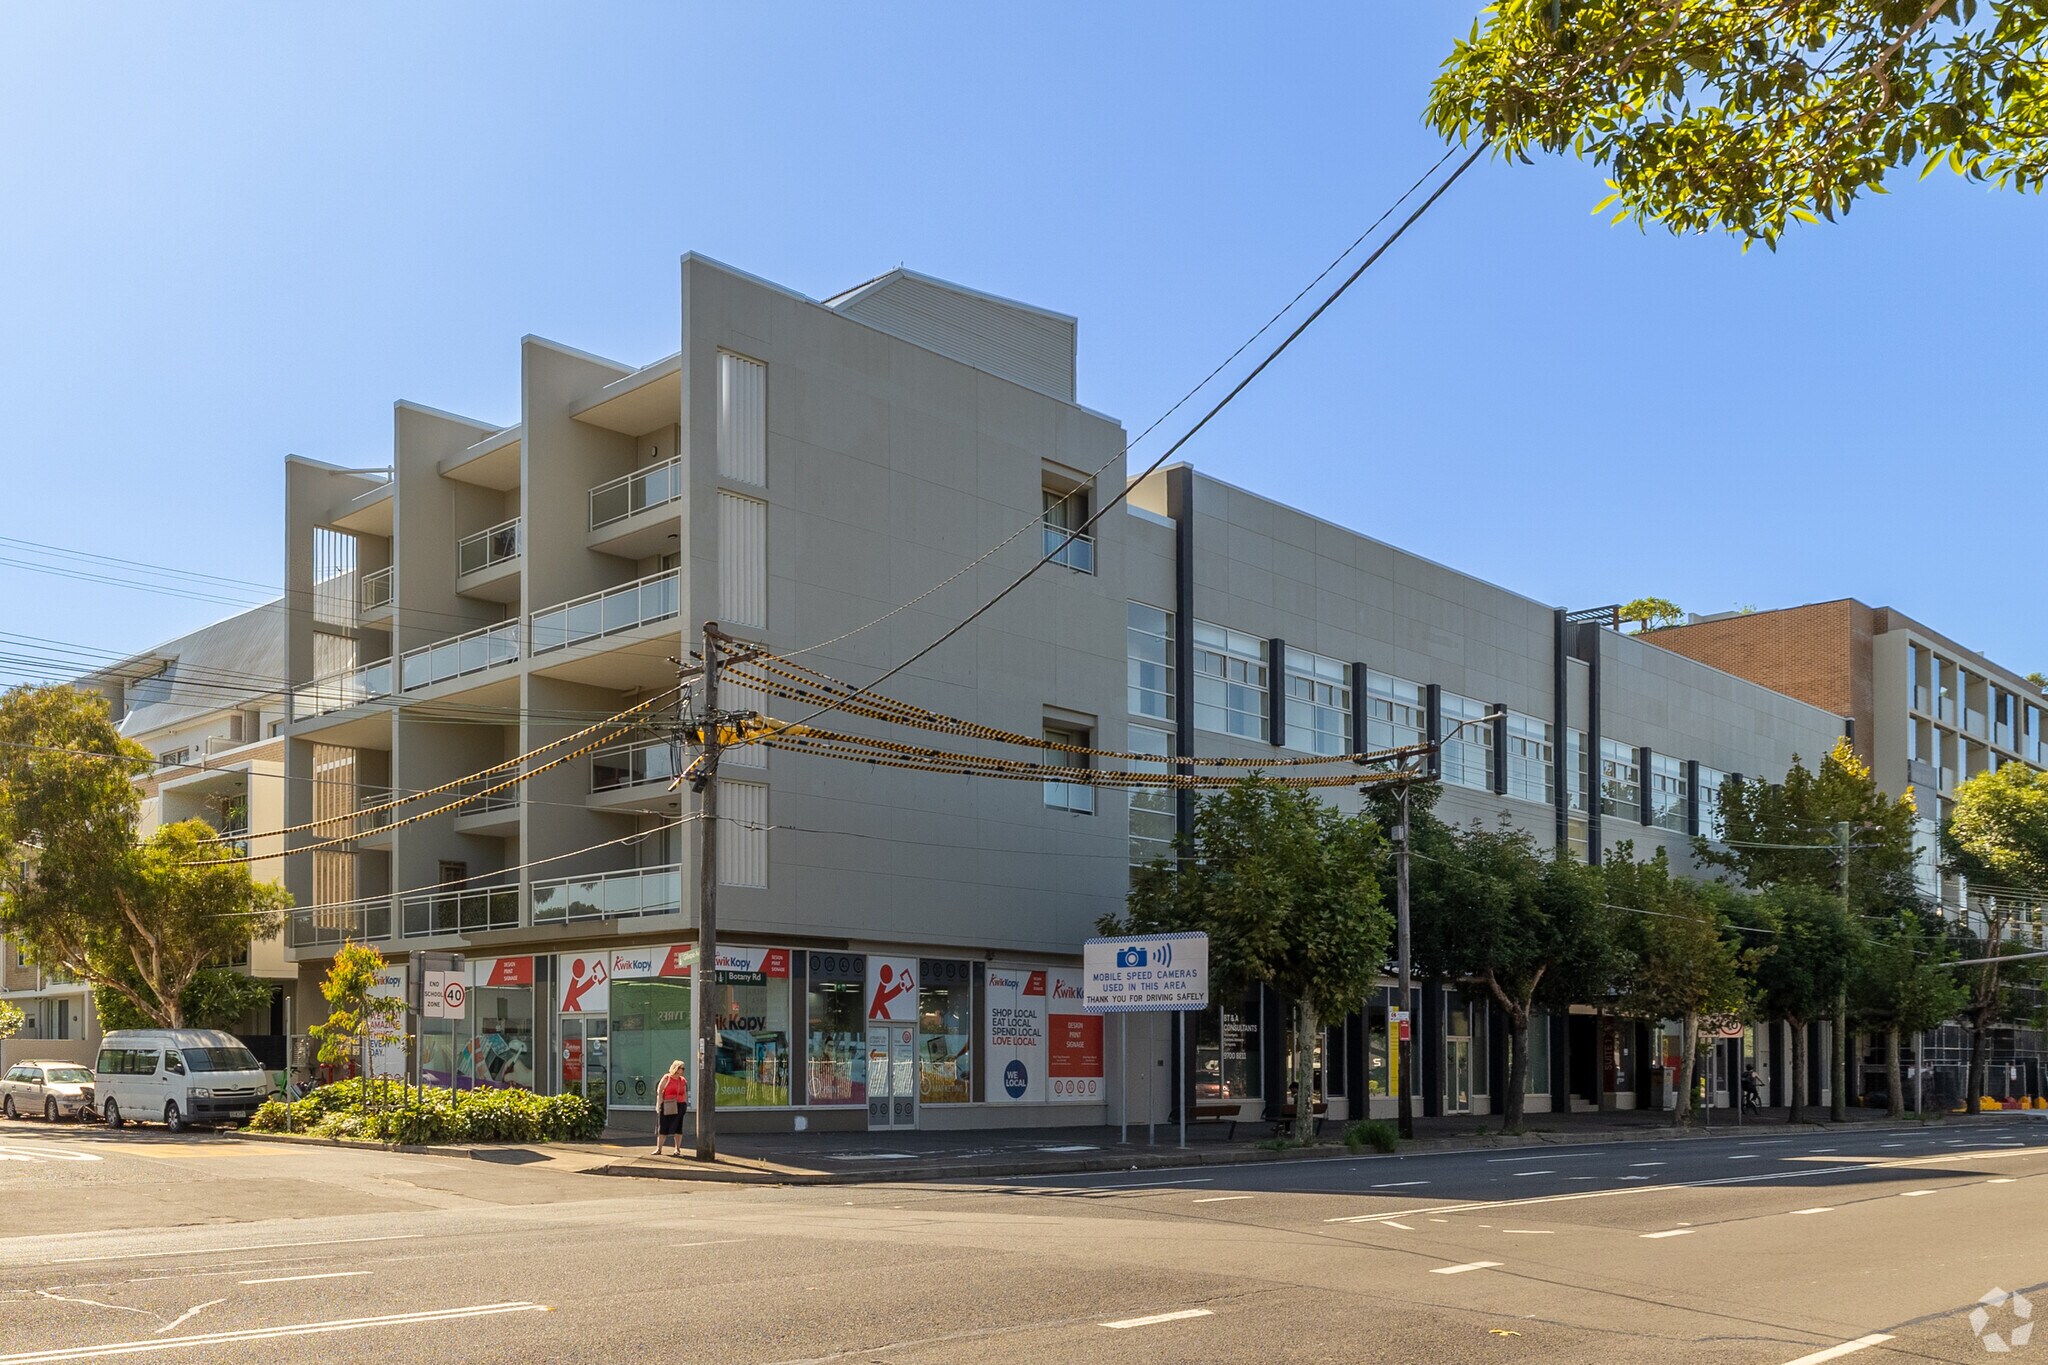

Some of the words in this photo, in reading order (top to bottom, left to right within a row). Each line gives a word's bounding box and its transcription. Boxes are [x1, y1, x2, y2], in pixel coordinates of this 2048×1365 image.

[728, 972, 751, 982] Botany
[1093, 972, 1122, 981] MOBILE
[1126, 971, 1152, 980] SPEED
[1157, 969, 1197, 979] CAMERAS
[1103, 984, 1124, 992] USED
[1128, 983, 1136, 991] IN
[1141, 982, 1158, 990] THIS
[1164, 981, 1186, 990] AREA
[447, 990, 461, 1001] 40
[1112, 995, 1126, 1003] YOU
[1130, 994, 1142, 1002] FOR
[1146, 993, 1174, 1002] DRIVING
[1176, 992, 1204, 1001] SAFELY
[992, 1008, 1012, 1018] SHOP
[1014, 1010, 1037, 1018] LOCAL
[1008, 1020, 1031, 1028] LOCAL
[992, 1028, 1016, 1036] SPEND
[1018, 1029, 1042, 1038] LOCAL
[992, 1037, 1012, 1046] LOVE
[1013, 1038, 1036, 1046] LOCAL
